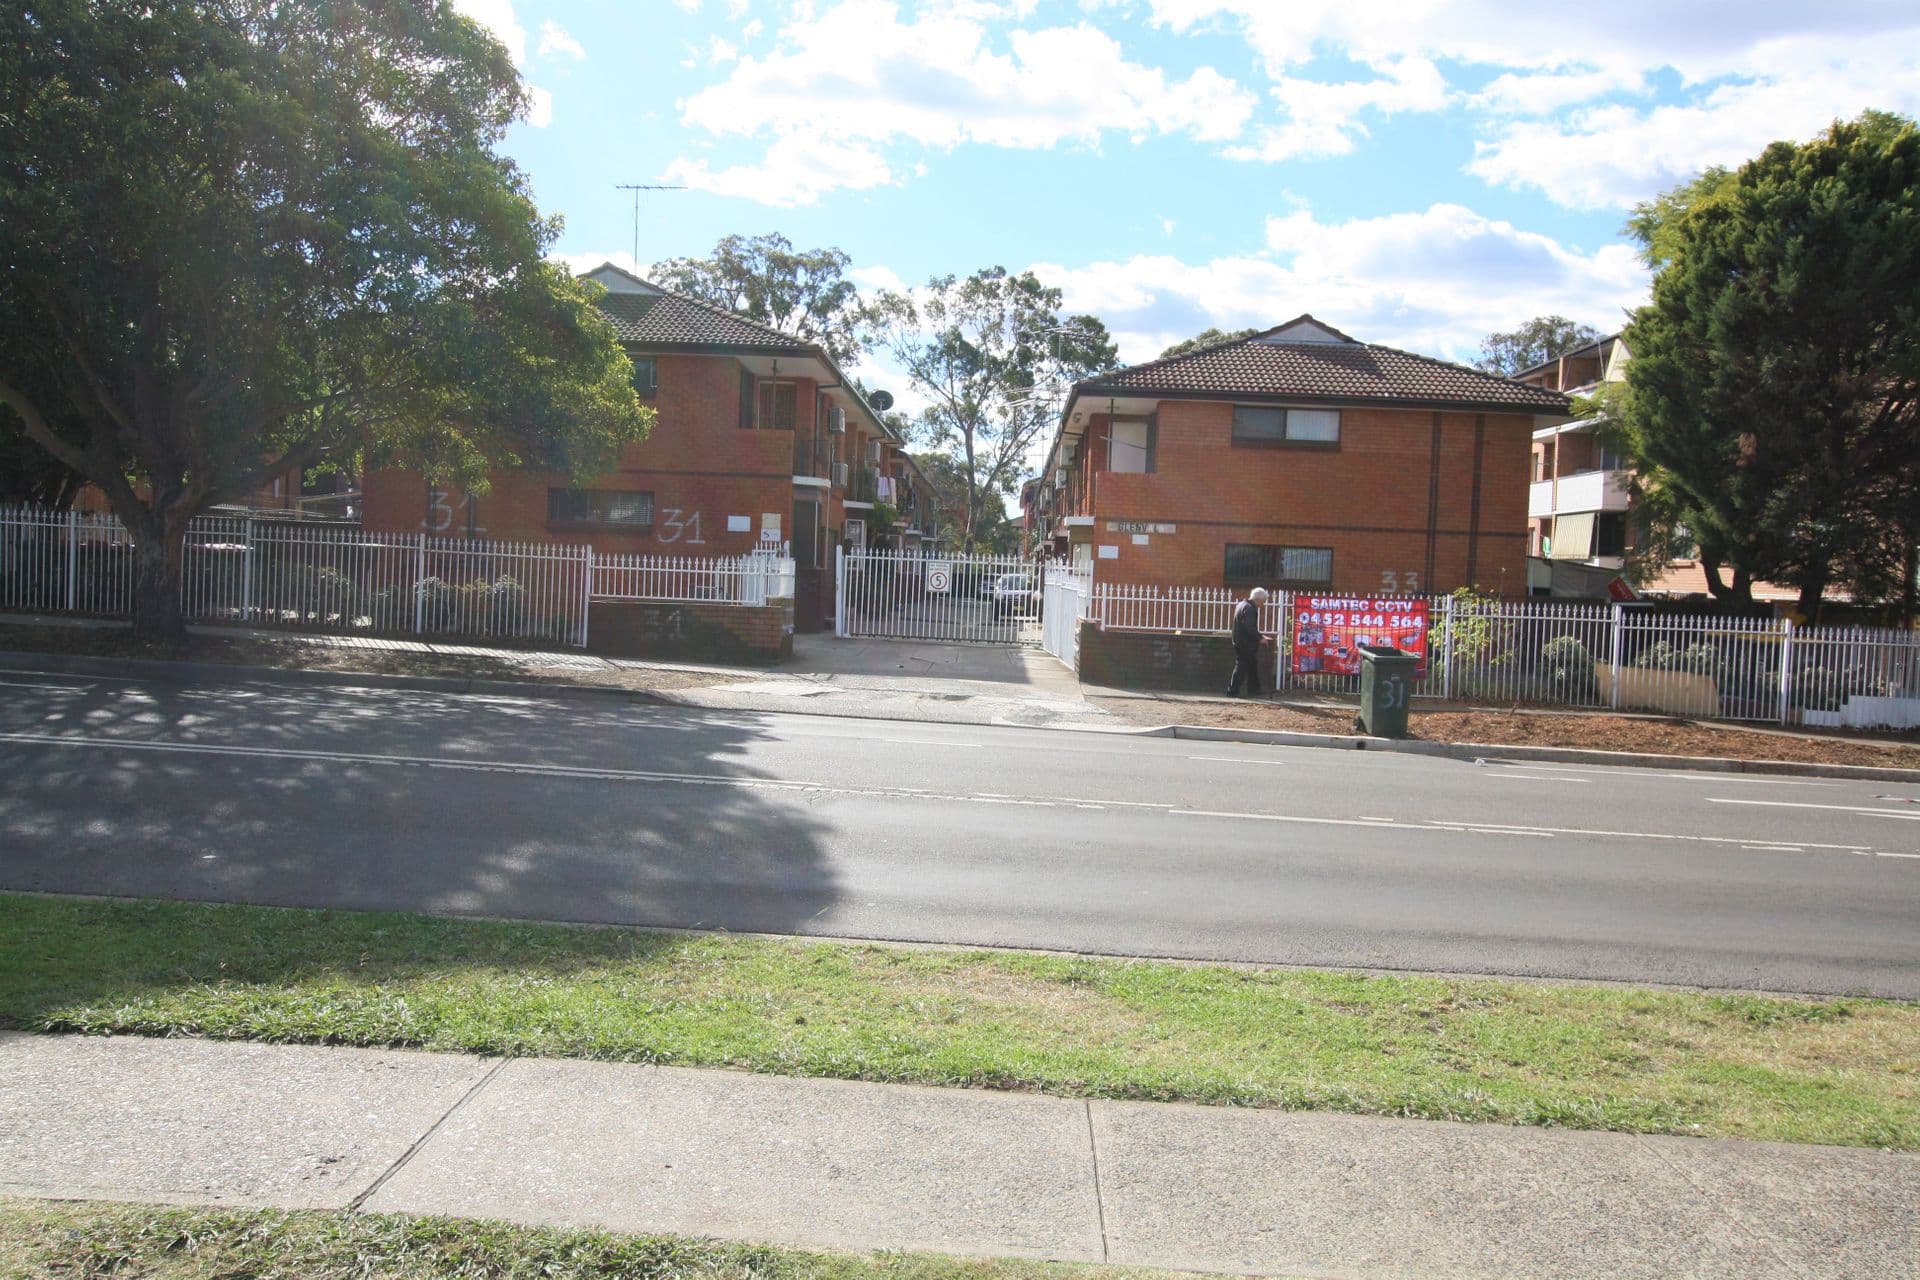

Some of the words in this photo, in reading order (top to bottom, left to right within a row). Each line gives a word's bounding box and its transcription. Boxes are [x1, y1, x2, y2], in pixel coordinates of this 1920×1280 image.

[658, 508, 706, 545] 31
[936, 575, 942, 587] 5
[1380, 571, 1418, 593] 33
[1311, 598, 1369, 611] SAMTEC
[1374, 600, 1413, 612] CCTV
[1299, 612, 1345, 626] 0452
[1350, 614, 1384, 627] 544
[1390, 615, 1422, 628] 564
[1381, 679, 1405, 709] 31
